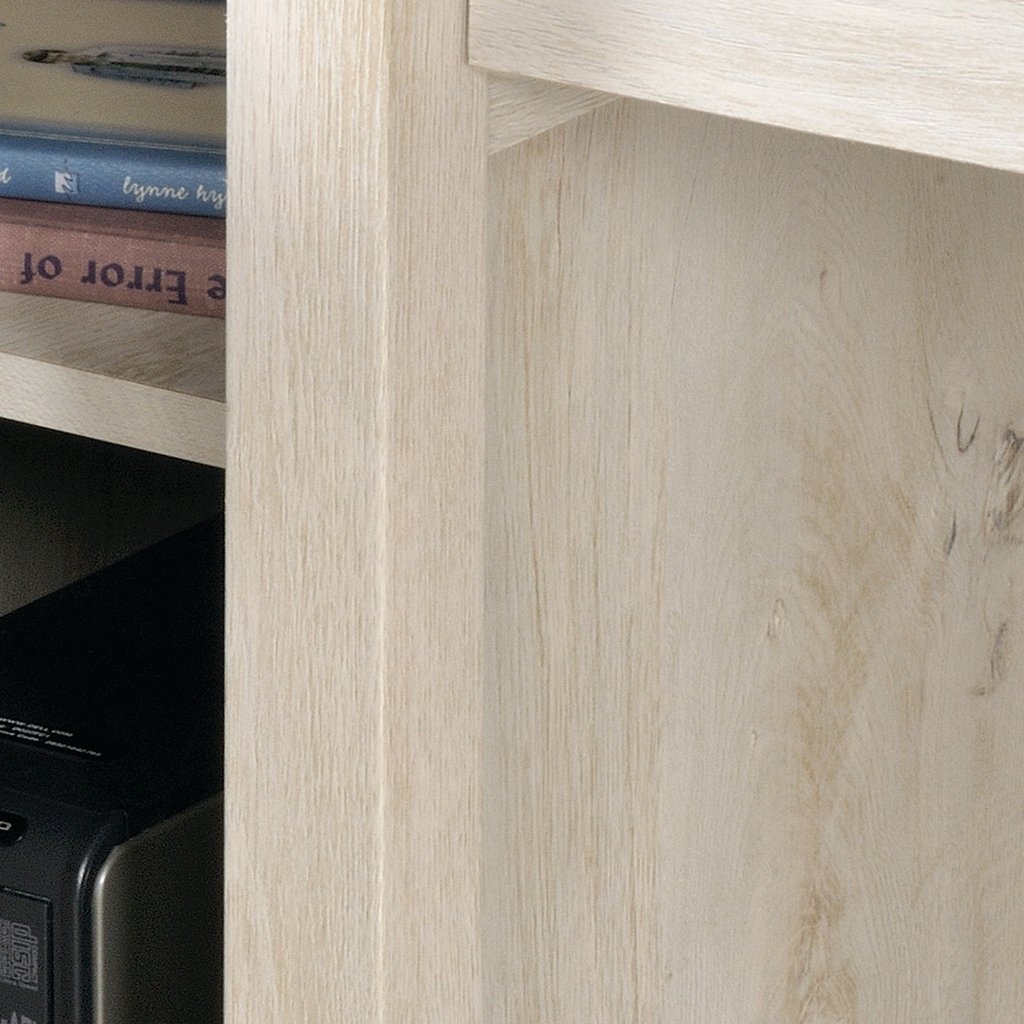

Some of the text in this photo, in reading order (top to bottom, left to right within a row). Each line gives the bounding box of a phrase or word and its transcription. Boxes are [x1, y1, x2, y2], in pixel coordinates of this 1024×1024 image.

[123, 176, 189, 203] lynne
[20, 252, 62, 285] of
[81, 260, 189, 305] Error
